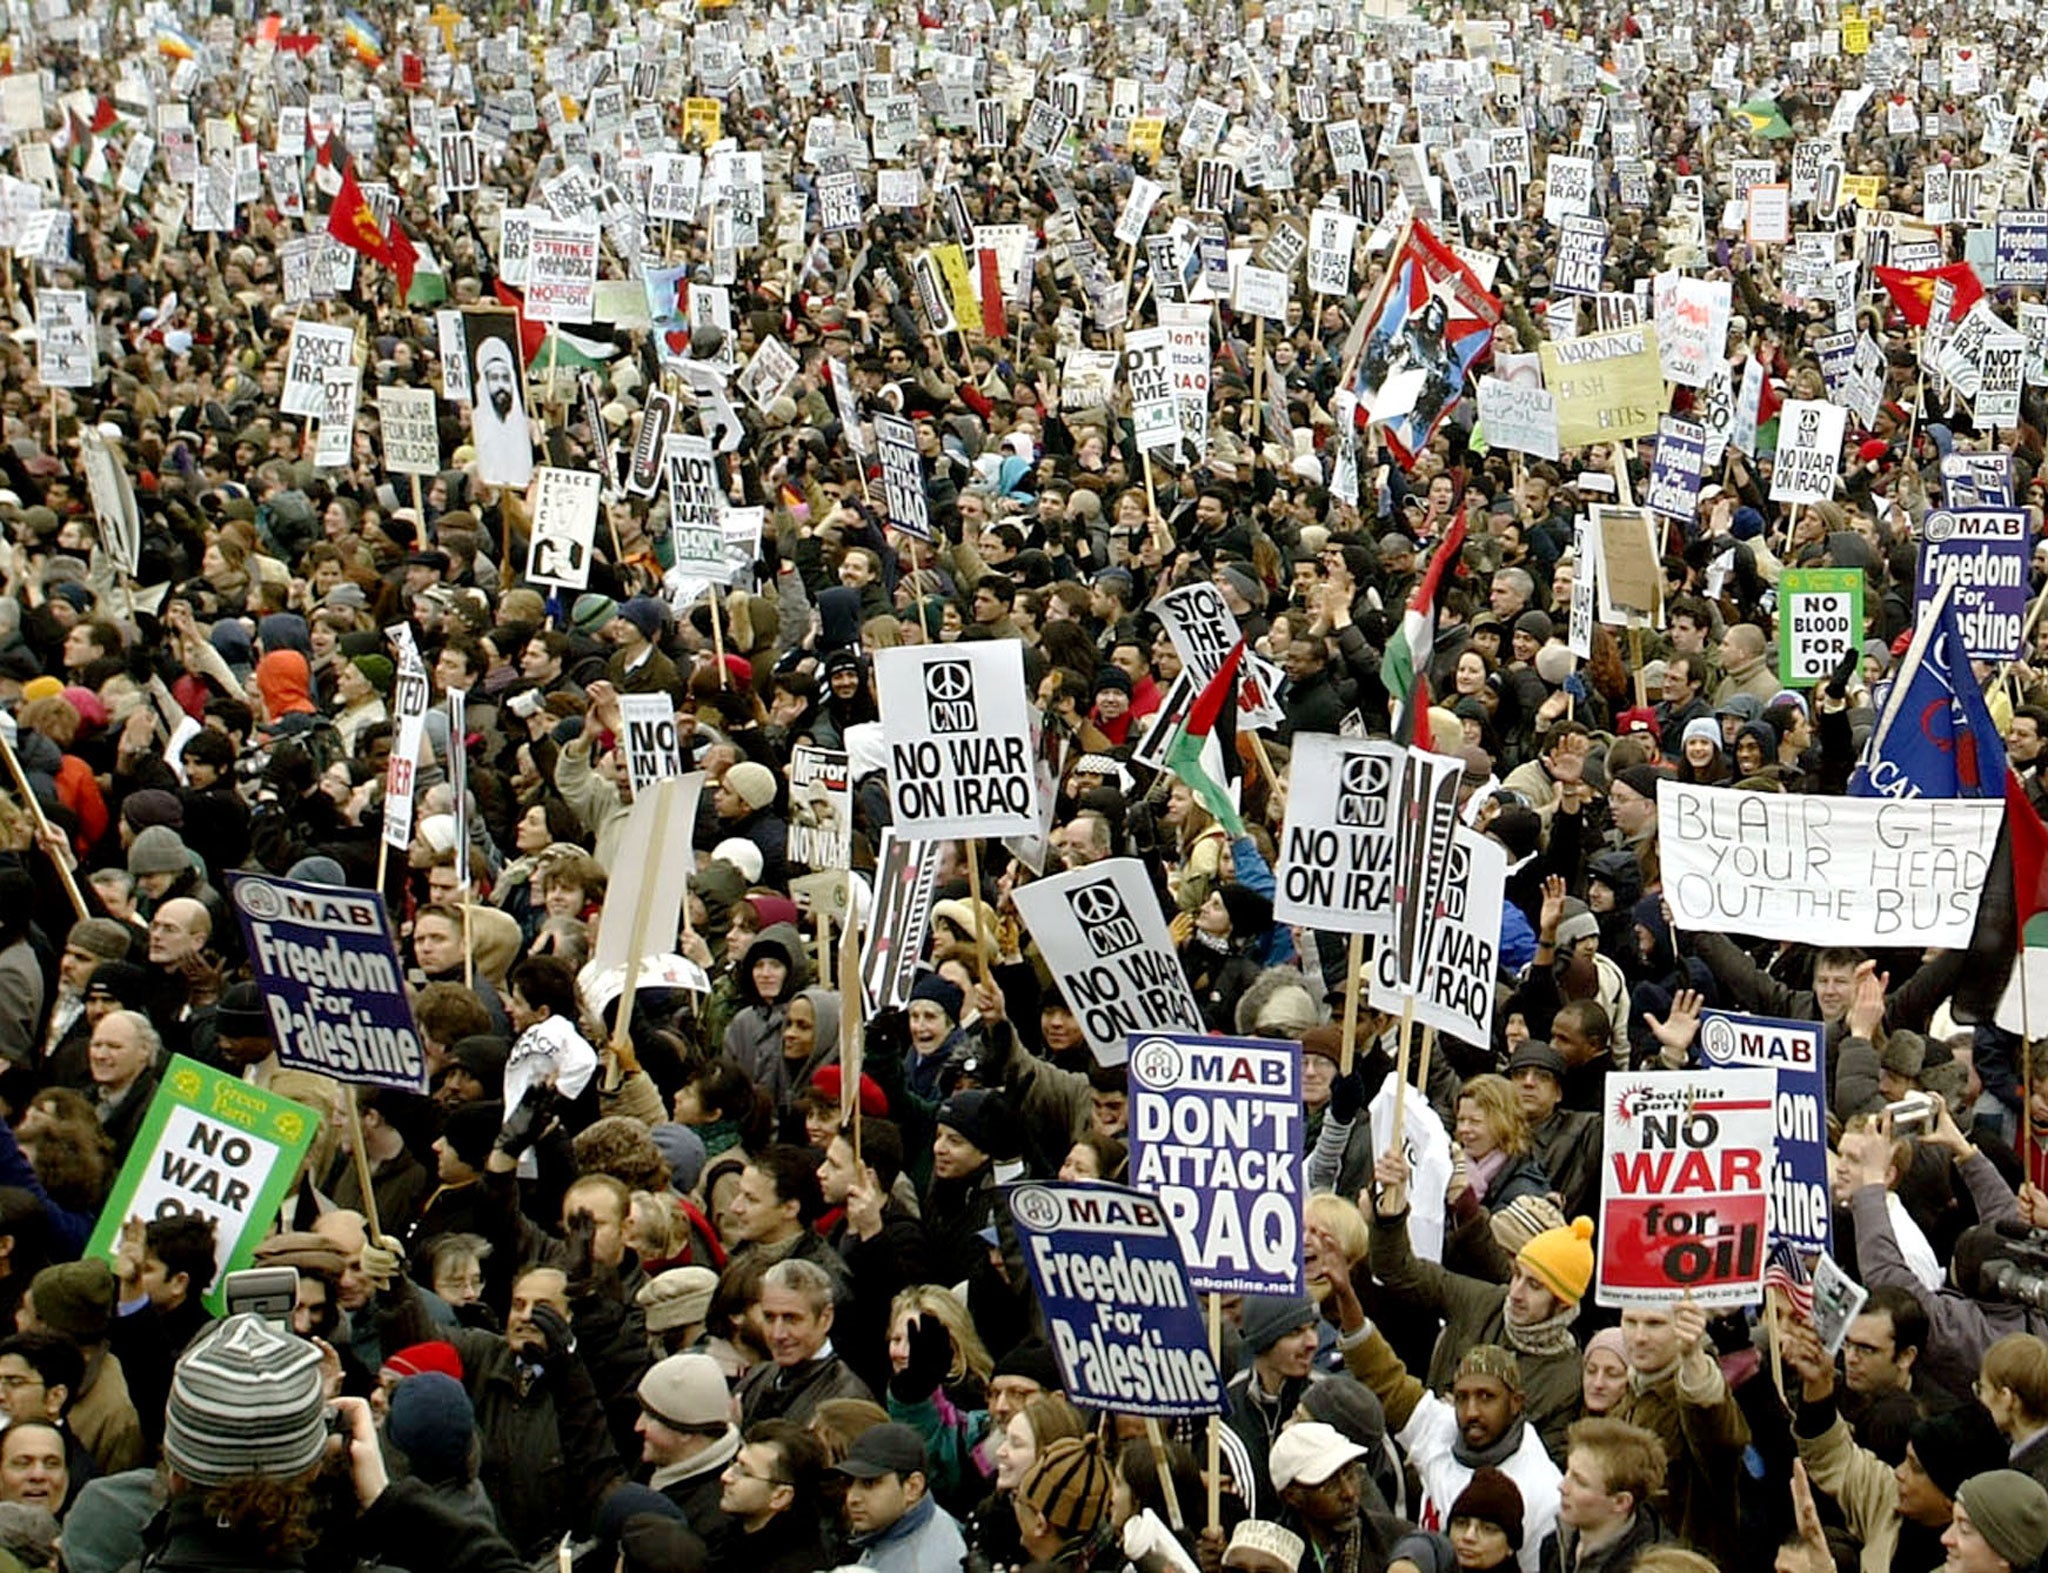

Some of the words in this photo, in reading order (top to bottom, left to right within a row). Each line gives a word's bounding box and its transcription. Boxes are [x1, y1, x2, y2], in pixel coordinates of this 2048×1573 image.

[1796, 169, 1818, 180] WA
[503, 243, 530, 260] IRA
[532, 241, 594, 258] STRIKE
[1555, 258, 1601, 294] IRAQ
[296, 334, 345, 353] DON'T
[1127, 344, 1164, 371] OT
[1172, 352, 1205, 365] ttack
[1984, 349, 2022, 366] NOT
[291, 363, 324, 386] IRA
[325, 381, 353, 399] OT
[1131, 366, 1167, 388] MY
[1133, 382, 1171, 404] ME
[671, 457, 713, 486] NOT
[1777, 448, 1797, 469] NO
[1799, 453, 1834, 475] WAR
[544, 471, 594, 488] PEACE
[1775, 469, 1793, 489] ON
[1794, 472, 1832, 496] IRAQ
[884, 482, 930, 535] IRAQ
[1958, 517, 2021, 536] MAB
[1923, 543, 2022, 588] Freedom
[1804, 596, 1838, 612] NO
[1953, 586, 1987, 607] For
[1181, 619, 1232, 656] THE
[1794, 617, 1849, 634] BLOOD
[1801, 638, 1845, 654] FOR
[929, 700, 978, 733] CND
[630, 721, 675, 752] NO
[632, 753, 657, 777] IN
[892, 740, 941, 781] NO
[948, 736, 1028, 775] WAR
[899, 780, 947, 820] ON
[955, 775, 1032, 819] IRAQ
[1337, 795, 1385, 828] CND
[1677, 792, 1832, 850] BLAIR
[1875, 802, 2004, 850] GET
[788, 824, 809, 864] NO
[813, 827, 851, 871] WAR
[1289, 826, 1338, 868] NO
[1350, 833, 1396, 873] WA
[1707, 844, 1832, 885] YOUR
[1870, 848, 1989, 890] HEAD
[1284, 864, 1335, 909] ON
[1343, 872, 1393, 911] IRA
[1677, 872, 1776, 920] OUT
[1794, 888, 1857, 922] THE
[1874, 888, 1971, 934] BUS
[286, 898, 375, 928] MAB
[1087, 916, 1143, 958] CND
[251, 921, 398, 994] Freedom
[1436, 926, 1493, 982] AR
[310, 987, 353, 1014] For
[1064, 965, 1120, 1010] NO
[1433, 969, 1488, 1031] RAQ
[266, 994, 421, 1077] Palestine
[1085, 1000, 1141, 1044] ON
[1739, 1033, 1812, 1063] MAB
[1190, 1054, 1287, 1087] MAB
[1136, 1091, 1300, 1152] DON'T
[1641, 1112, 1720, 1150] NO
[187, 1121, 252, 1168] NO
[160, 1150, 251, 1213] WAR
[1137, 1143, 1297, 1193] ATTACK
[1611, 1148, 1764, 1195] WAR
[1066, 1197, 1161, 1229] MAB
[1642, 1202, 1718, 1238] for
[1158, 1184, 1300, 1281] RAQ
[1031, 1234, 1189, 1309] Freedom
[1096, 1302, 1143, 1335] For
[1050, 1317, 1221, 1403] Palestine
